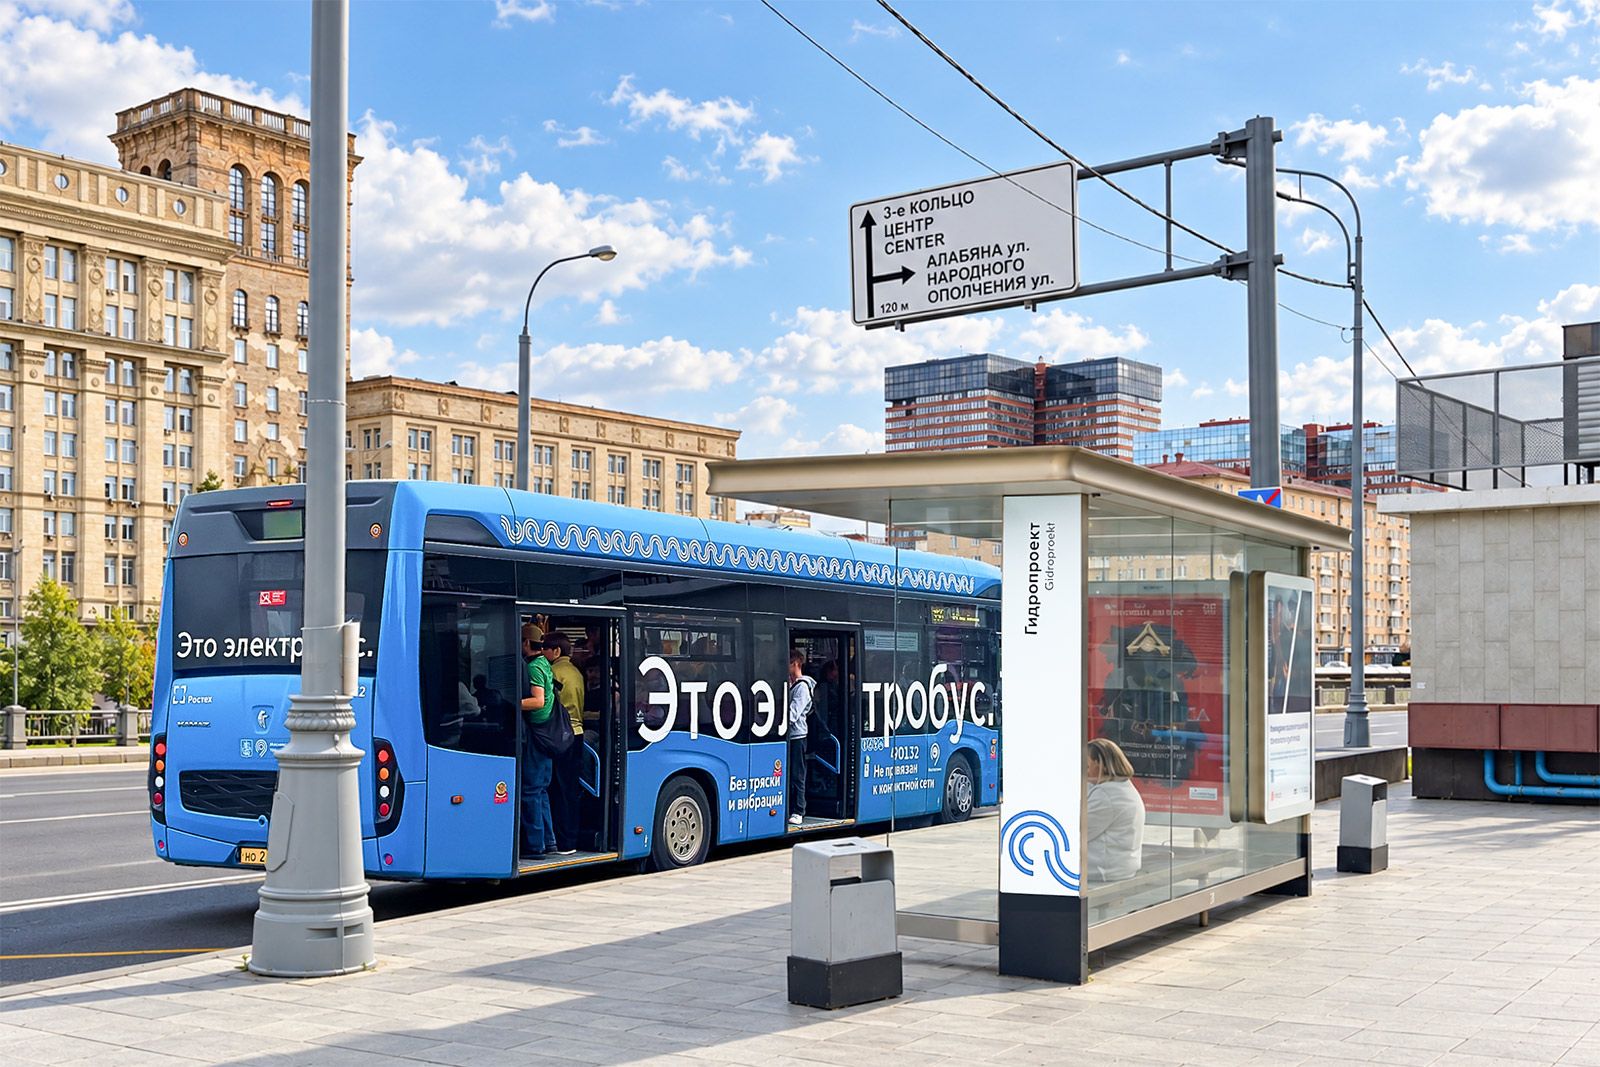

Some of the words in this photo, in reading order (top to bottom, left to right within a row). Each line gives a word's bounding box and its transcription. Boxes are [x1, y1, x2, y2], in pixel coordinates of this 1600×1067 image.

[884, 206, 905, 219] 3-е
[910, 190, 974, 214] КОЛЬЦО
[884, 216, 934, 239] ЦЕНТР
[885, 233, 945, 255] CENTER
[927, 244, 1002, 268] АЛАБЯНА
[1007, 242, 1030, 259] ул.
[927, 258, 1025, 286] НАРОДНОГО
[927, 276, 1026, 304] ОПОЛЧЕНИЯ
[1031, 275, 1054, 290] ул.
[880, 302, 898, 314] 120
[1044, 522, 1056, 591] Gidroproekt
[1024, 522, 1041, 635] Гидропроект
[176, 631, 217, 659] Это
[223, 636, 373, 663] электрс.
[187, 695, 213, 705] Ростех
[638, 655, 743, 743] Это
[873, 765, 884, 778] Не
[729, 776, 747, 791] Без
[750, 776, 781, 792] тряски
[872, 785, 878, 795] к
[879, 777, 919, 794] конктной
[919, 779, 935, 790] сети
[728, 800, 735, 811] и
[737, 792, 783, 812] вибраций
